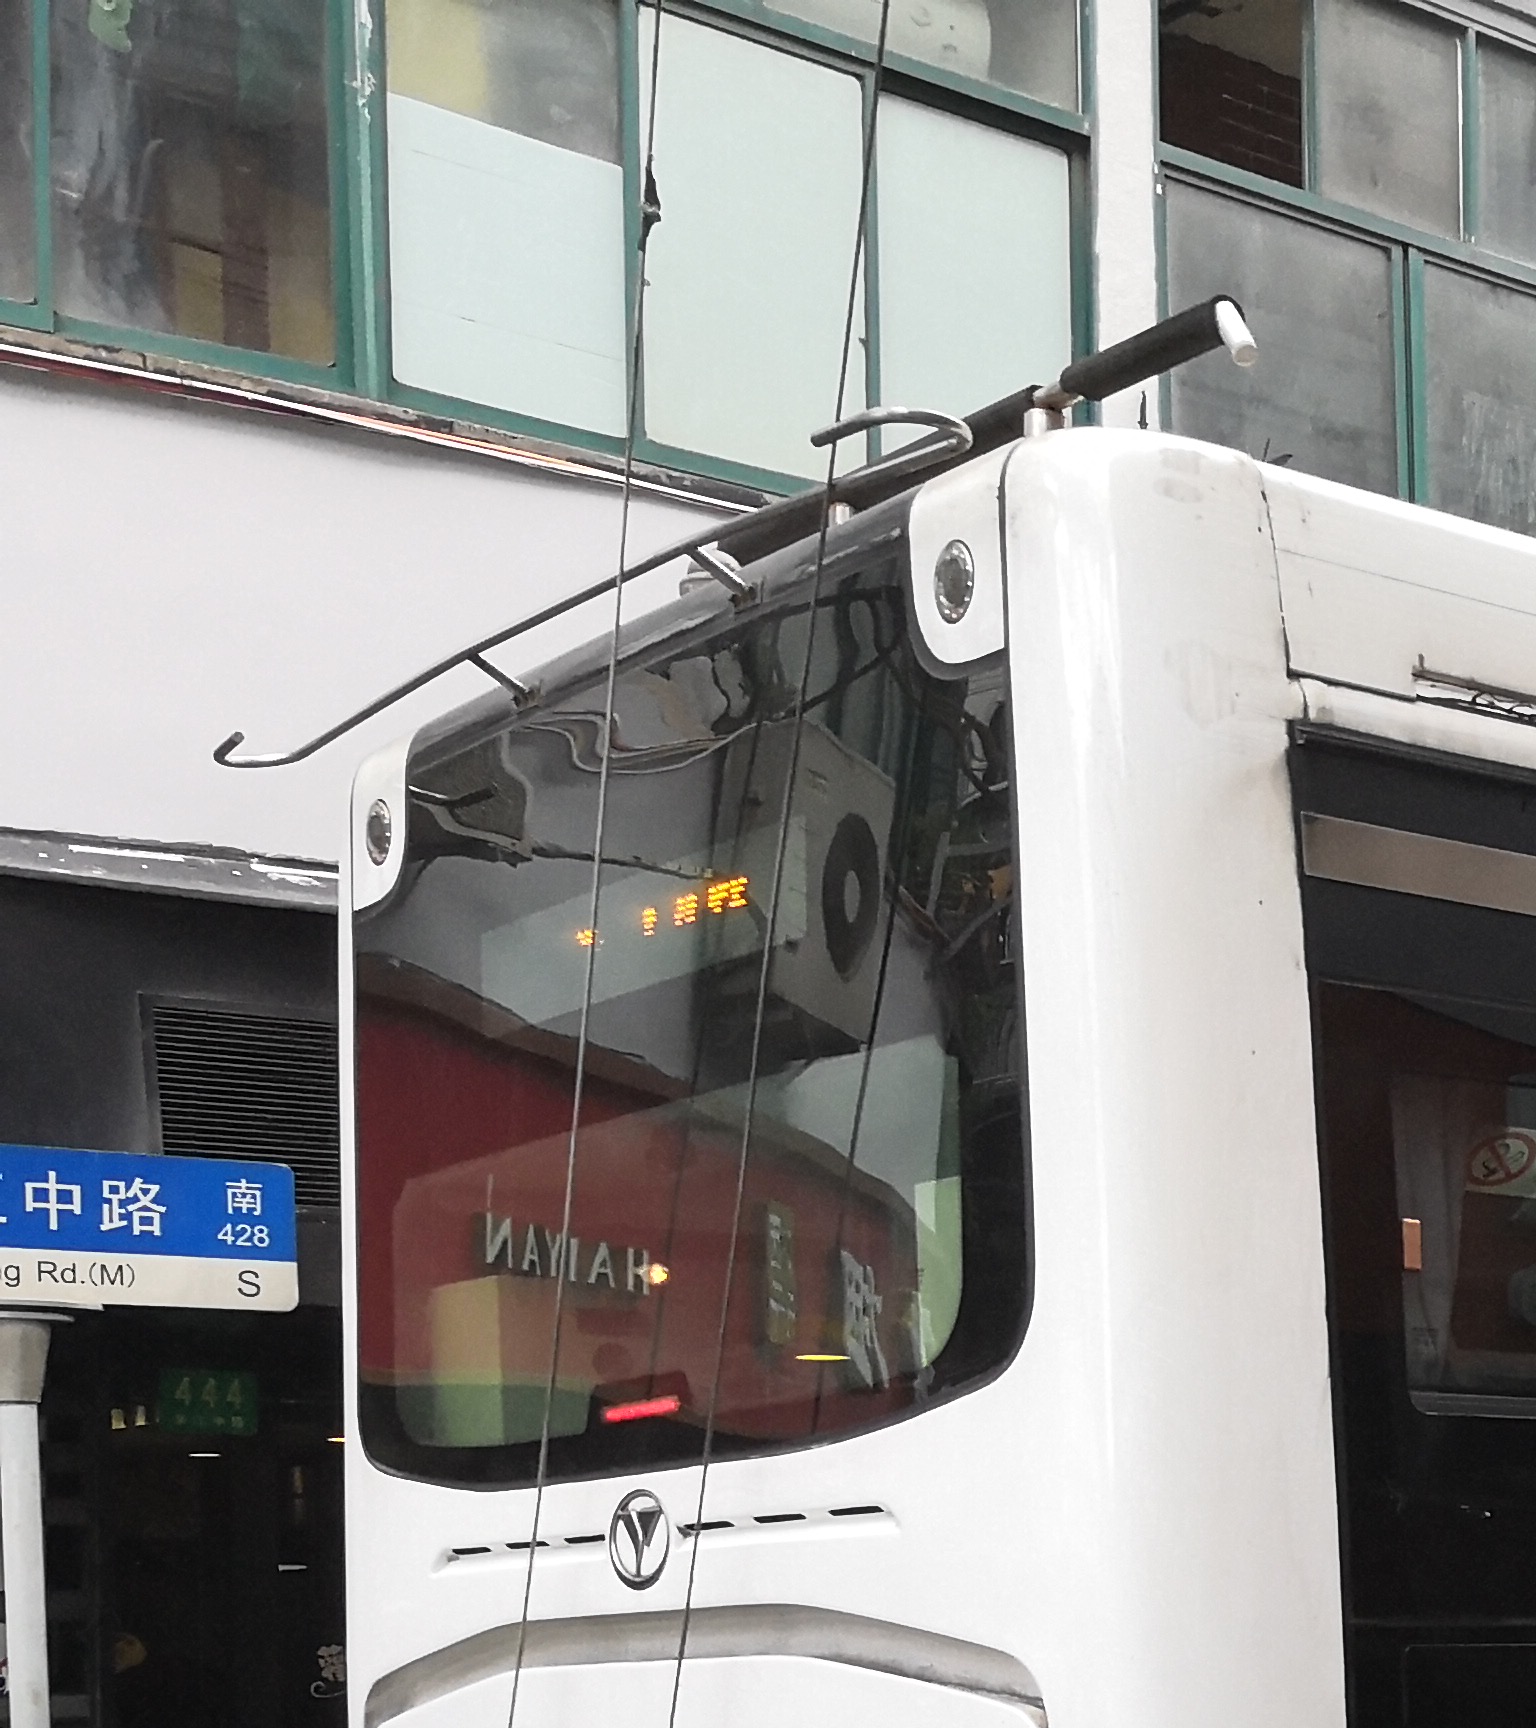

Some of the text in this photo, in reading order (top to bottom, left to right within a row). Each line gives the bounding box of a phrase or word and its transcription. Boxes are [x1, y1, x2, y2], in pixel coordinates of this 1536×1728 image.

[0, 1170, 167, 1236] 中路
[225, 1178, 263, 1216] 南
[217, 1223, 271, 1248] 428
[37, 1260, 136, 1288] Rd.(M)
[237, 1270, 261, 1298] S
